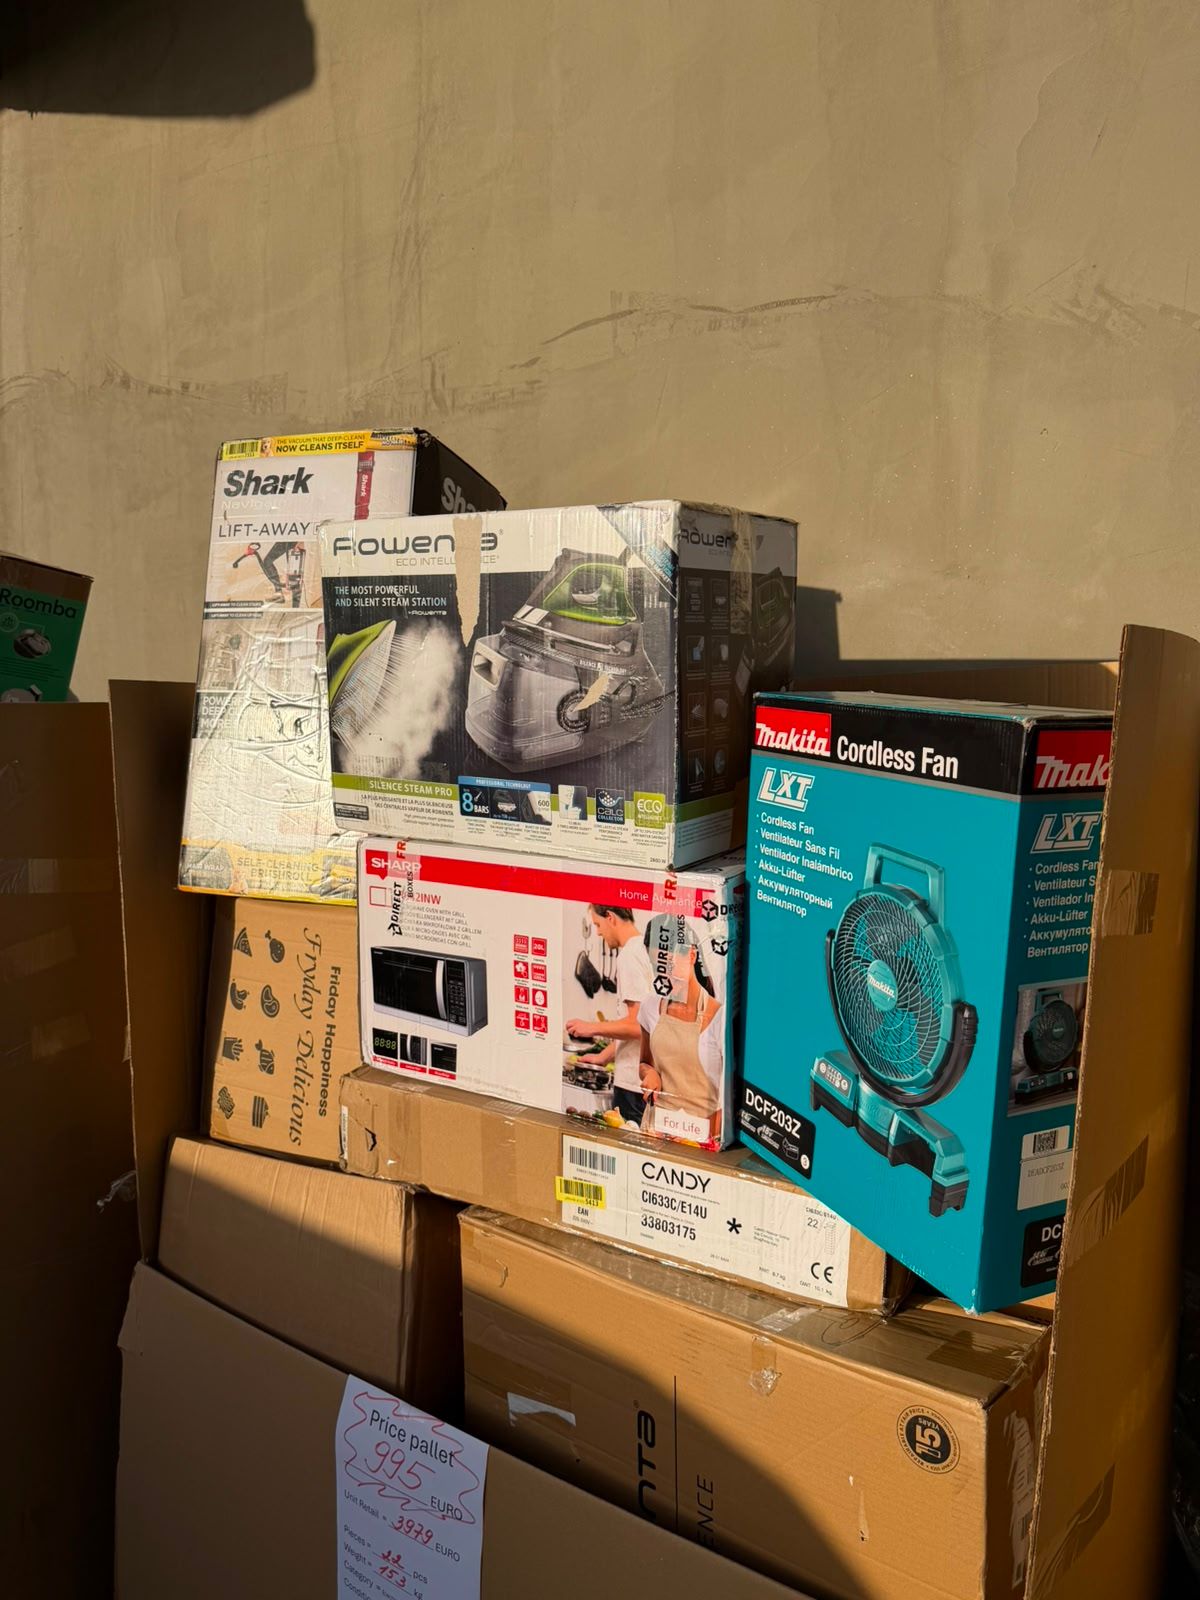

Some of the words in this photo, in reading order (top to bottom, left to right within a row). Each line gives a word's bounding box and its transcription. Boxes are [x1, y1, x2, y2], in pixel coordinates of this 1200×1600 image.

[276, 444, 297, 453] NOW
[299, 442, 333, 452] CLEANS
[335, 441, 364, 450] ITSELF
[224, 467, 313, 497] Shark
[219, 522, 311, 538] LIFT-AWAY
[396, 557, 418, 567] ECO
[335, 586, 350, 595] THE
[351, 585, 373, 595] MOST
[374, 585, 420, 595] POWERFUL
[335, 598, 352, 607] AND
[353, 598, 381, 607] SILENT
[382, 597, 410, 607] STEAM
[411, 597, 447, 607] STATION
[0, 588, 77, 619] Roomba
[837, 735, 915, 772] Cordless
[921, 747, 959, 779] Fan
[369, 780, 402, 792] SILENCE
[404, 783, 433, 795] STEAM
[434, 786, 453, 797] PRO
[757, 767, 815, 812] LXT
[462, 792, 474, 812] 8
[474, 805, 490, 814] BARS
[538, 799, 550, 808] 600
[637, 798, 663, 813] ECO
[597, 814, 624, 823] COLLECTOR
[761, 812, 797, 831] Cordless
[798, 821, 815, 836] Fan
[760, 828, 803, 849] Ventilateur
[805, 838, 827, 856] Sans
[828, 846, 841, 860] Fil
[1030, 811, 1103, 854] LXT
[237, 857, 319, 873] SELF-CLEANING
[371, 857, 422, 873] SHARP
[758, 859, 806, 883] Akku-Lüfter
[760, 843, 800, 864] Ventilador
[801, 854, 854, 881] Inalámbrico
[1035, 860, 1080, 875] Cordless
[620, 889, 649, 902] Home
[758, 875, 833, 910] Аккумуляторный
[1034, 877, 1087, 892] Ventilateur
[391, 881, 402, 922] DIRECT
[757, 890, 807, 918] Вентилятор
[1032, 894, 1082, 909] Ventilador
[677, 914, 686, 945] BOXES
[1030, 909, 1089, 925] Akku-Lüfter
[657, 925, 670, 974] DIRECT
[1027, 942, 1089, 959] Вентилятор
[293, 926, 323, 1021] Fryday
[328, 965, 342, 1020] Friday
[319, 1022, 337, 1118] Happiness
[288, 1029, 315, 1147] Delicious
[664, 1116, 680, 1128] For
[682, 1122, 701, 1135] Life
[745, 1088, 802, 1140] DCF203Z
[641, 1161, 712, 1194] CANDY
[577, 1206, 589, 1217] EAN
[585, 1198, 599, 1208] 5413
[641, 1190, 708, 1220] CI633C/E14U
[641, 1214, 697, 1241] 33803175
[807, 1217, 819, 1229] 22
[811, 1262, 834, 1284] CE
[917, 1417, 941, 1432] YEARS
[369, 1409, 407, 1444] Price
[409, 1433, 455, 1468] pallet
[915, 1424, 942, 1459] 15
[364, 1440, 436, 1490] 995
[429, 1494, 464, 1522] EURO
[344, 1488, 358, 1505] Unit
[358, 1497, 380, 1520] Retail
[394, 1515, 434, 1545] 3979
[434, 1542, 461, 1562] EURO
[344, 1524, 366, 1545] Pieces
[412, 1570, 429, 1585] pcs
[344, 1542, 367, 1566] Weight
[379, 1565, 407, 1589] 153
